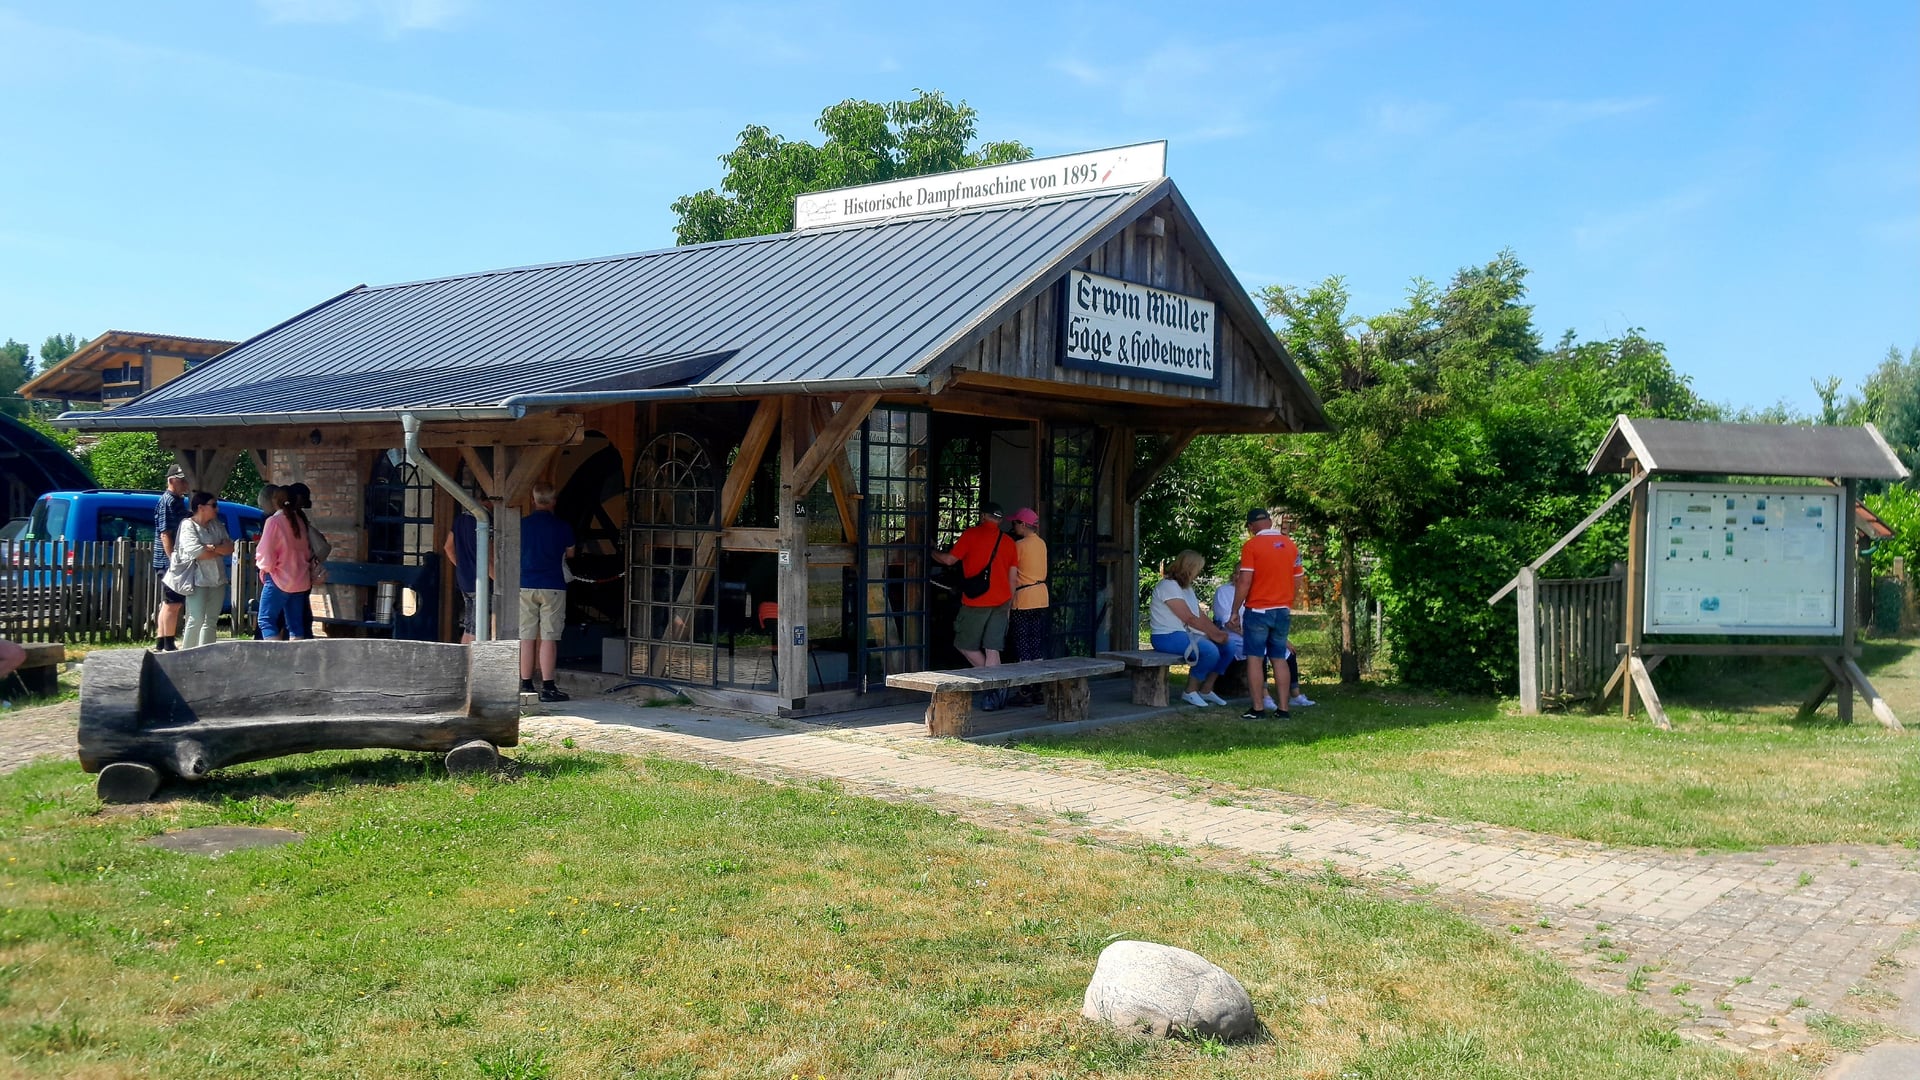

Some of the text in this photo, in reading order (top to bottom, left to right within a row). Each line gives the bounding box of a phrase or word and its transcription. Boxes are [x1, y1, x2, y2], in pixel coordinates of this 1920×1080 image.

[844, 163, 1097, 215] Historische Dampfmaschine von 1895
[1077, 274, 1209, 333] Erwin Müller
[1068, 316, 1112, 361] Säge
[796, 503, 806, 514] 5A
